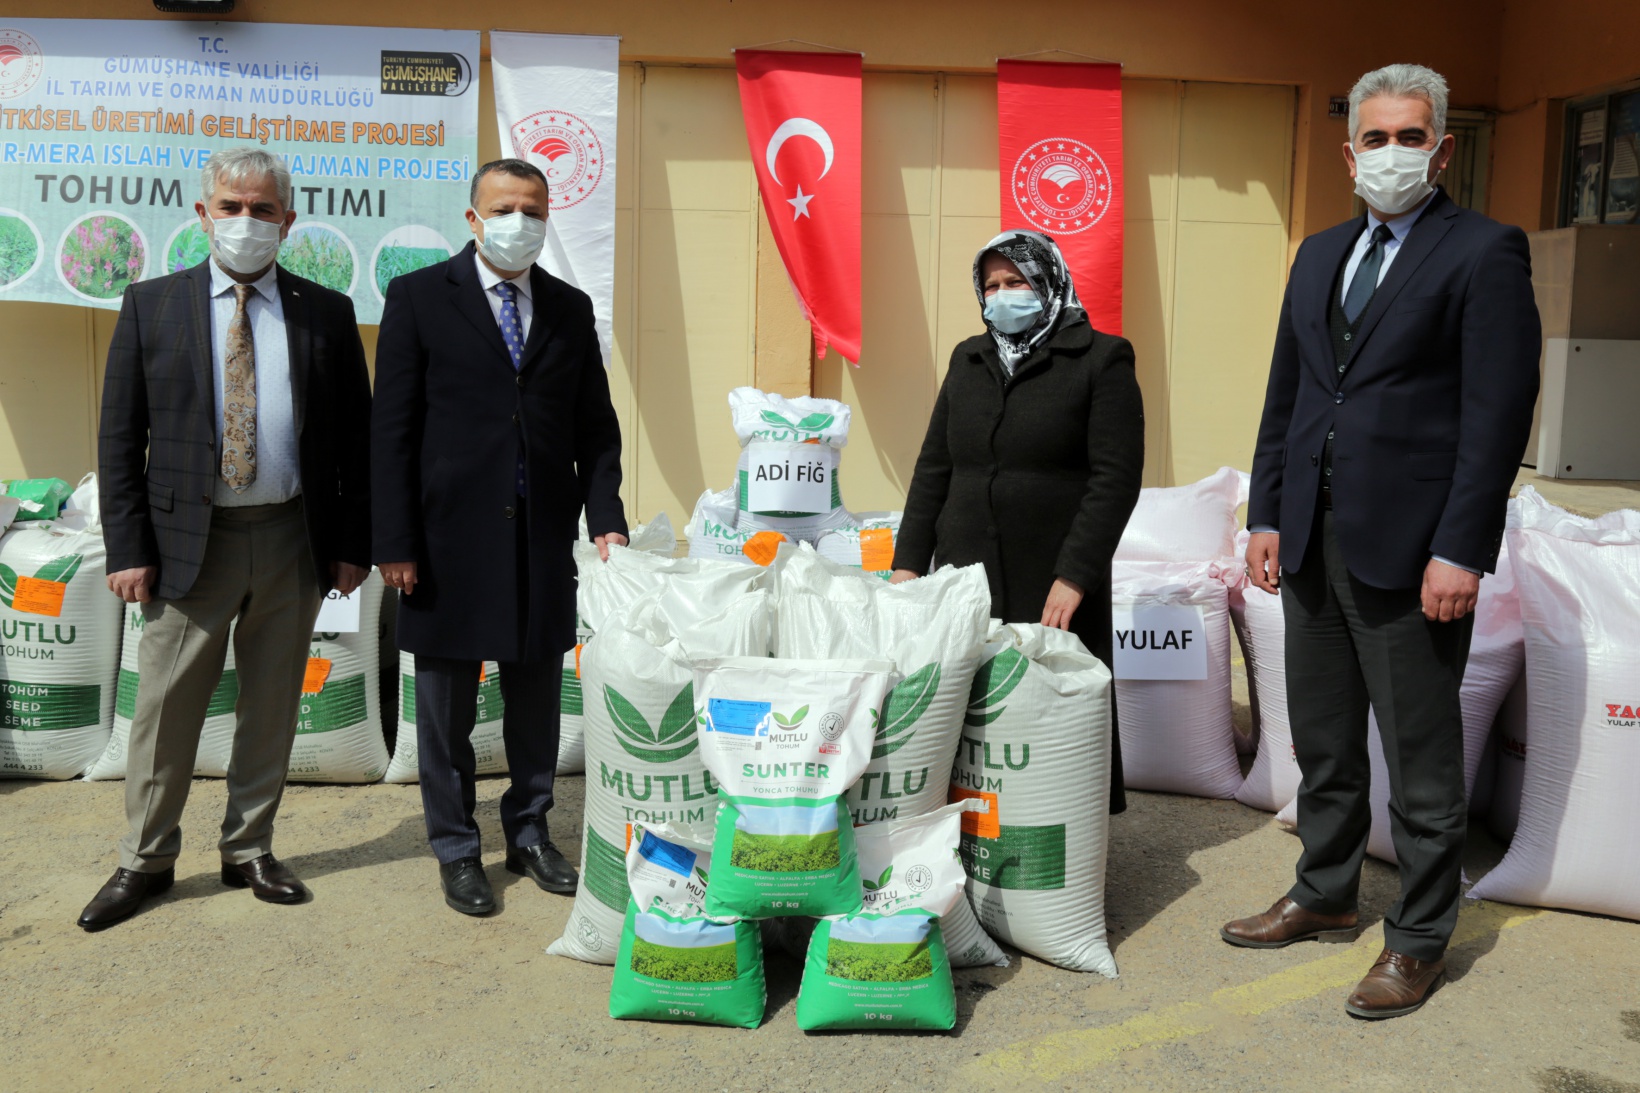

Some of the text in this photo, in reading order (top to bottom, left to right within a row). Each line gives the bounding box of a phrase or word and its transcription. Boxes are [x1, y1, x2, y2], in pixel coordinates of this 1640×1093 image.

[198, 37, 228, 53] T.C.
[104, 54, 319, 82] GÜMÜŞHANE VALİLİĞİ
[47, 76, 374, 108] İL TARIM VE ORMAN MÜDÜRLÜĞÜ
[0, 104, 444, 146] TKİSEL ÜRETİMİ GELİŞTİRME PROJESİ
[0, 142, 96, 164] R-MERA
[104, 144, 171, 167] ISLAH
[378, 156, 469, 181] PROJESİ
[34, 174, 183, 207] TOHUM
[756, 460, 824, 483] ADİ FİĞ
[2, 619, 76, 644] UTLU
[1116, 630, 1193, 650] YULAF
[2, 684, 48, 696] TOHUM
[6, 700, 40, 712] SEED
[5, 716, 42, 726] SEME
[1606, 719, 1636, 728] YULAF
[769, 733, 808, 743] MUTLU
[742, 762, 830, 778] SUNTER
[952, 767, 1002, 792] OHUM
[785, 786, 819, 794] TOHUMU
[962, 838, 990, 859] EED
[962, 858, 991, 880] EME
